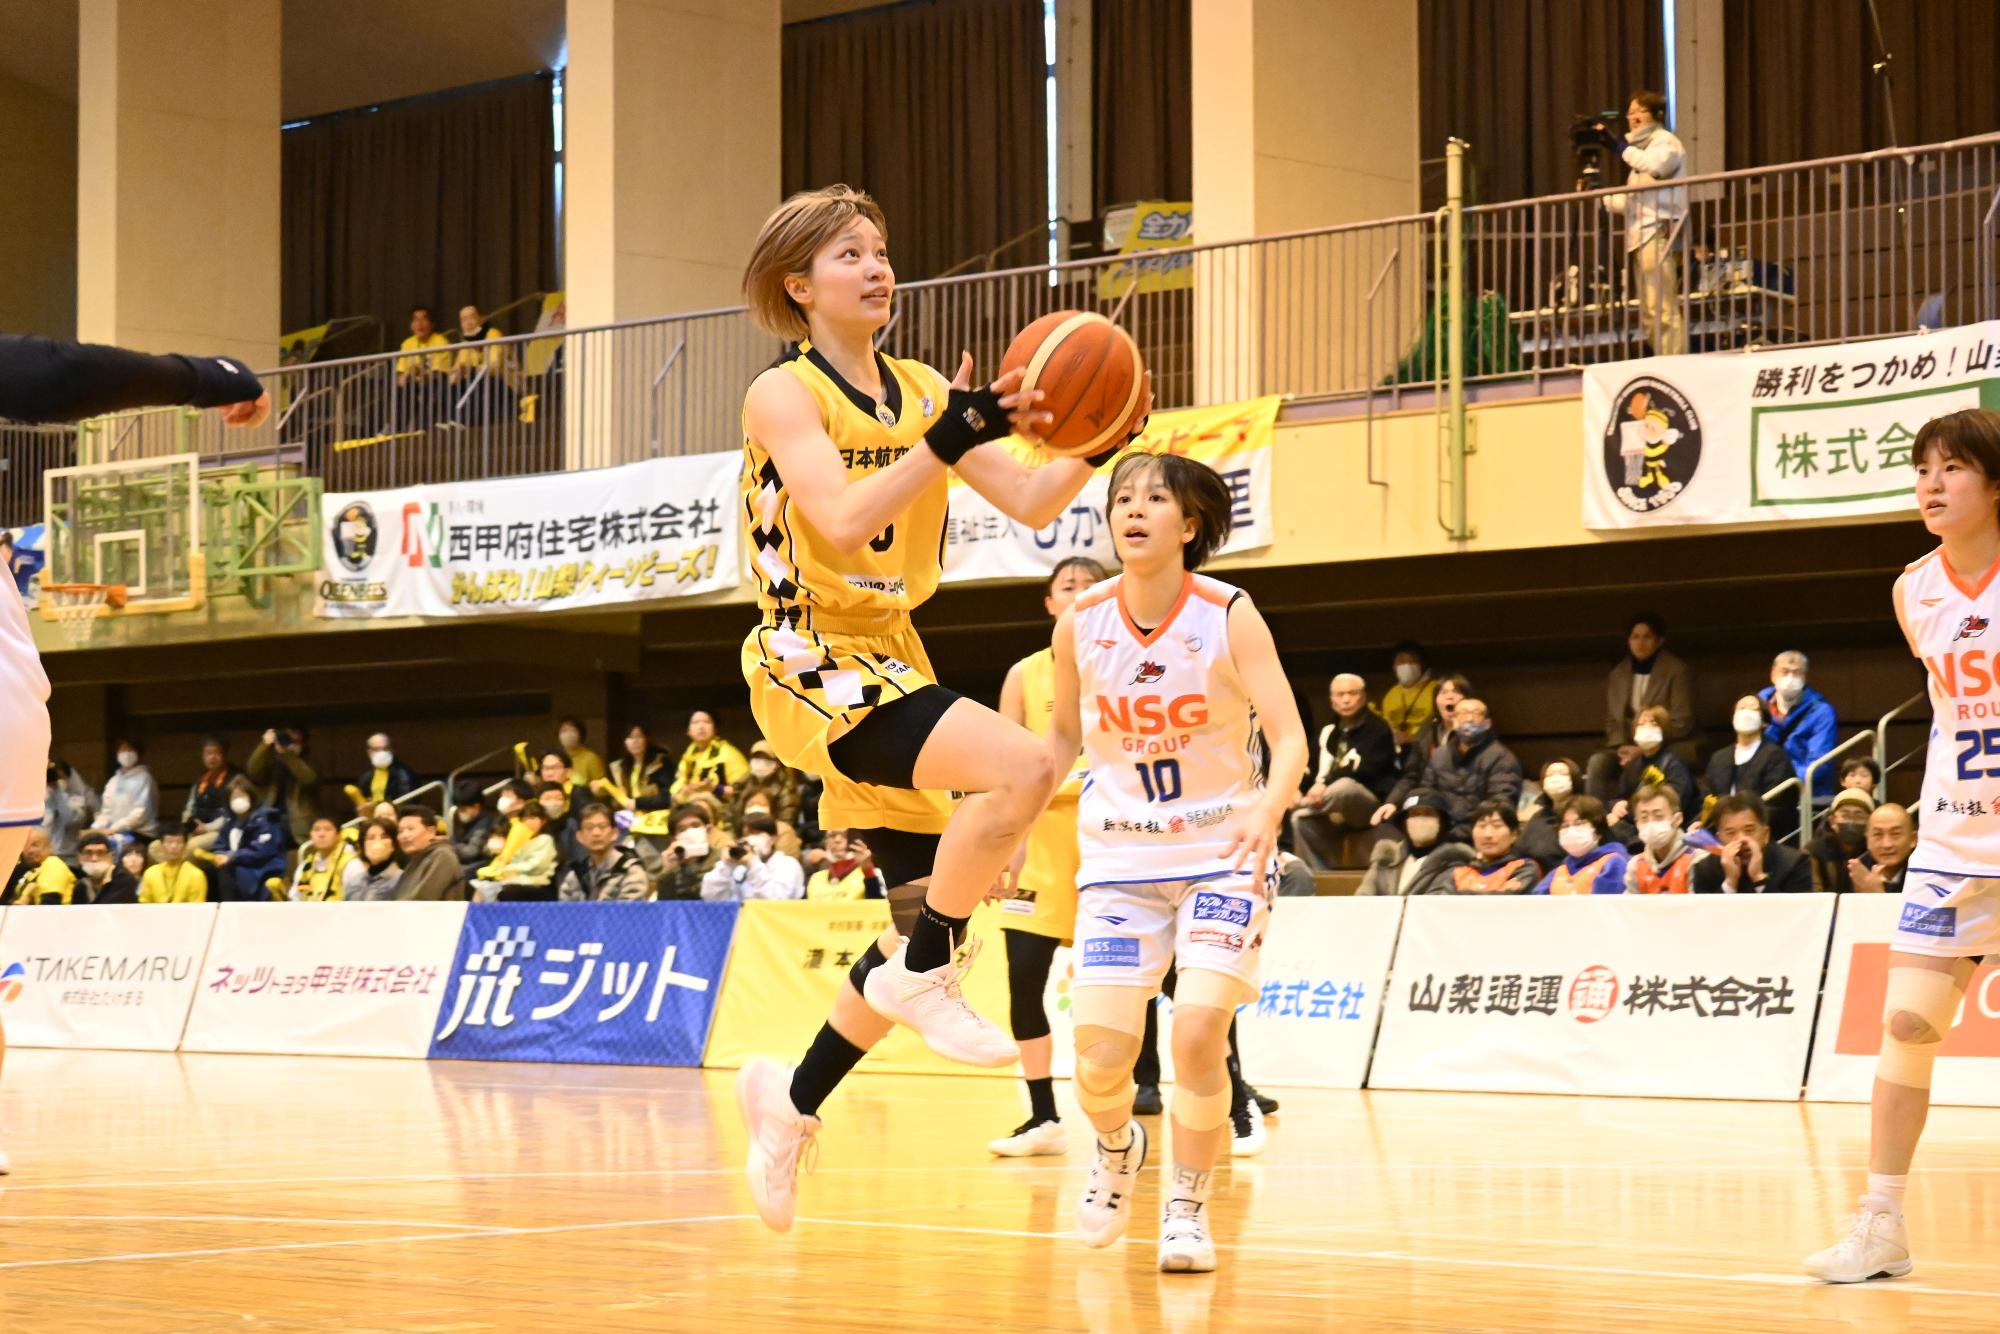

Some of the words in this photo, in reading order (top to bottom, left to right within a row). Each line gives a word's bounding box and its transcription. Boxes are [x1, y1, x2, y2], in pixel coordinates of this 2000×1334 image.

[840, 446, 914, 469] 日本航空
[1775, 421, 1917, 480] 株式会
[448, 498, 721, 563] 西甲府住宅株式会社
[1926, 650, 2000, 698] NS
[1096, 694, 1209, 735] NSG
[1122, 734, 1192, 754] GROUP
[1135, 758, 1183, 803] 10
[1185, 803, 1233, 823] SEKIYA
[35, 956, 192, 982] TAKEMARU
[210, 965, 437, 994] ネッツトヨタ甲斐株式会社
[530, 942, 709, 1022] ジット
[437, 945, 525, 1040] jit
[1258, 980, 1366, 1020] 株式会社
[1409, 973, 1563, 1016] 山梨通運
[1623, 975, 1795, 1018] 株式会社
